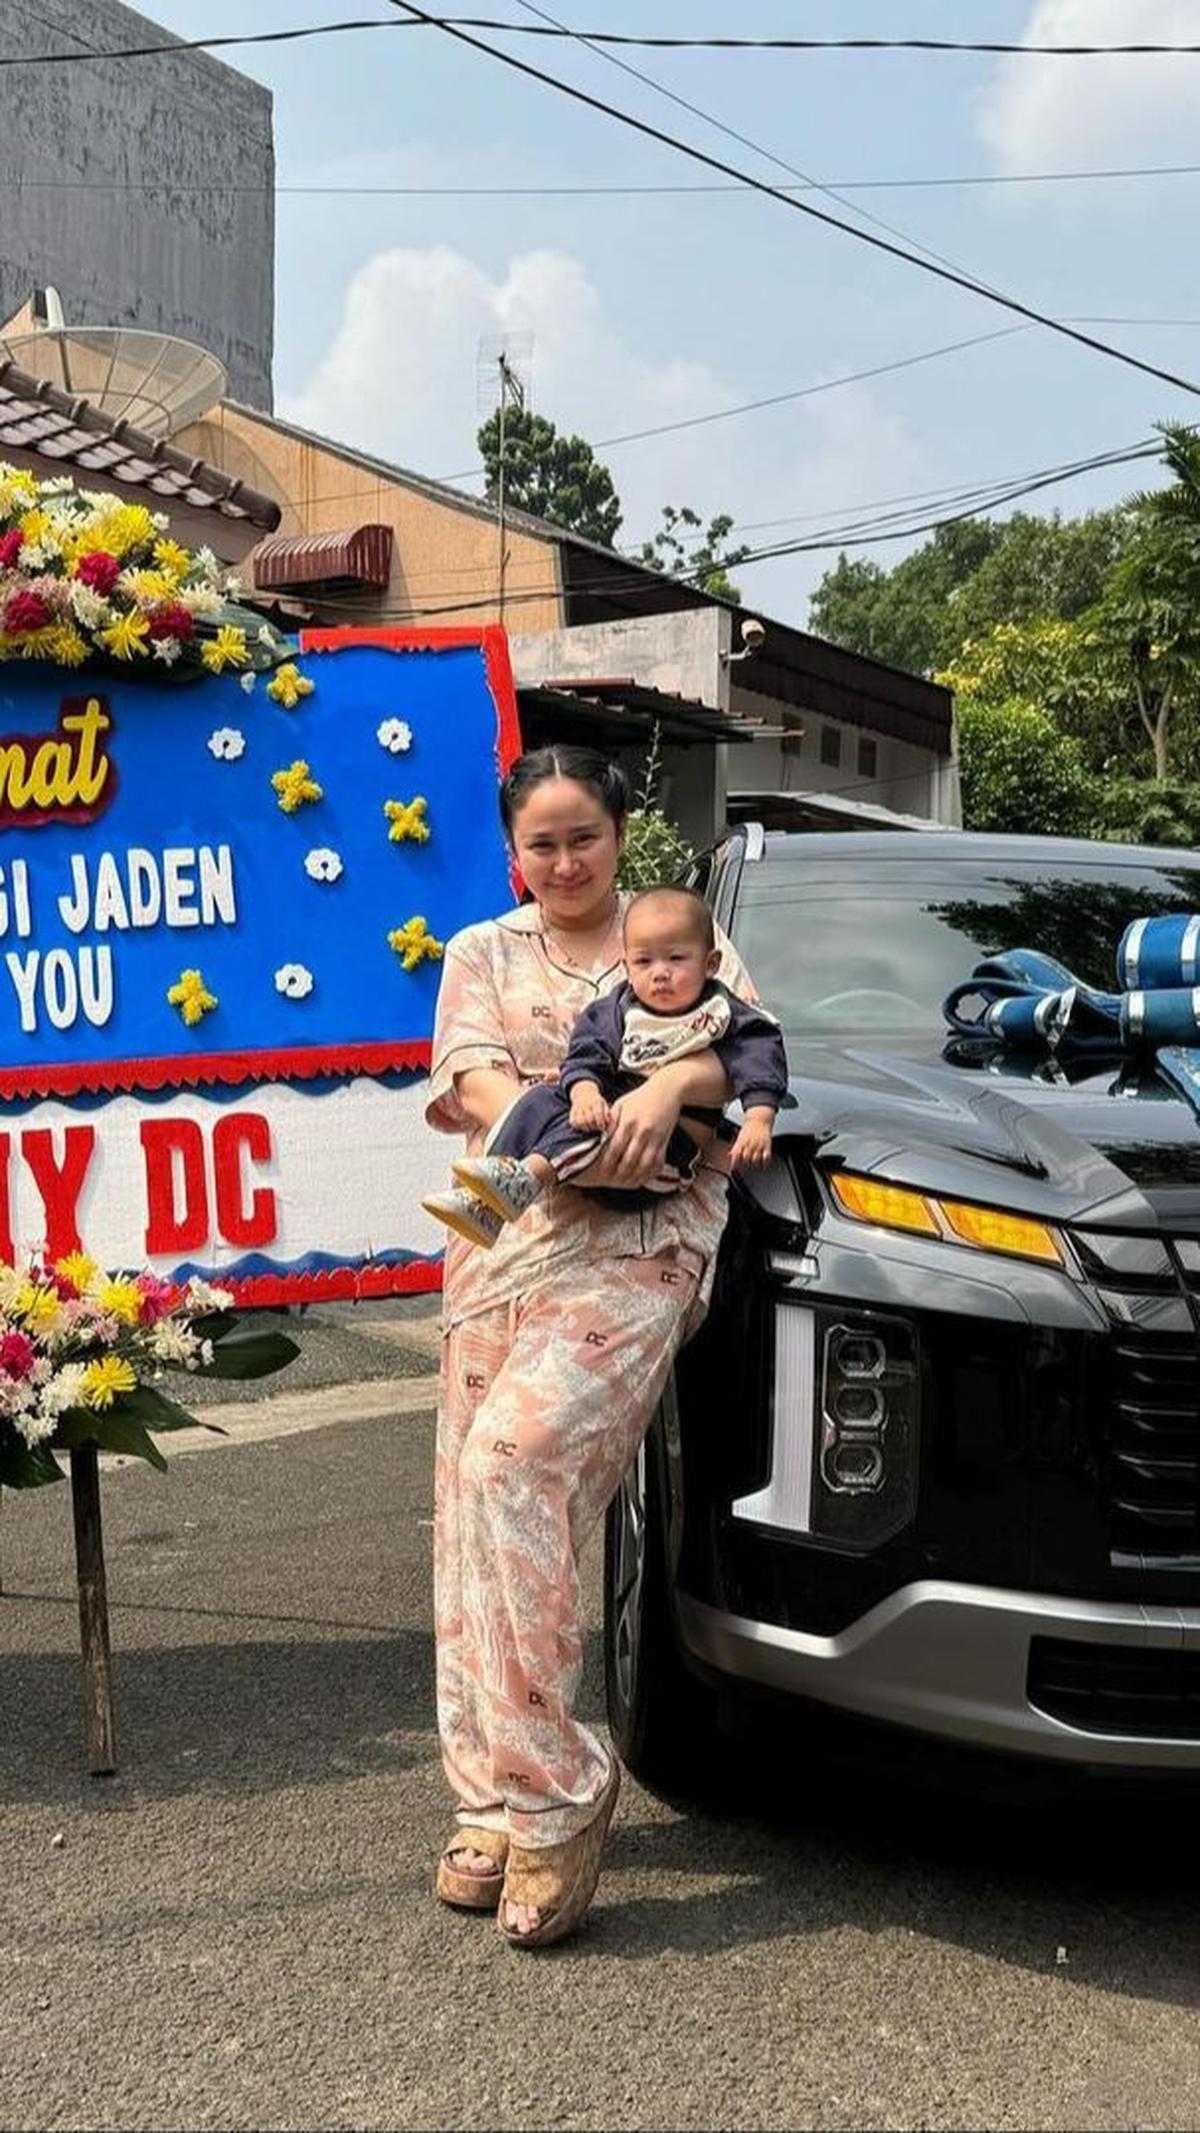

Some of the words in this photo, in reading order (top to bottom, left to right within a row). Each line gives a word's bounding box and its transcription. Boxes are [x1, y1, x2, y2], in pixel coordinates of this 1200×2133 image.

[58, 845, 236, 933] JADEN
[6, 945, 114, 1032] YOU
[531, 1005, 551, 1019] DC
[0, 1124, 95, 1268] Y
[140, 1112, 278, 1256] DC
[466, 1374, 486, 1390] DC
[492, 1439, 518, 1457] DC
